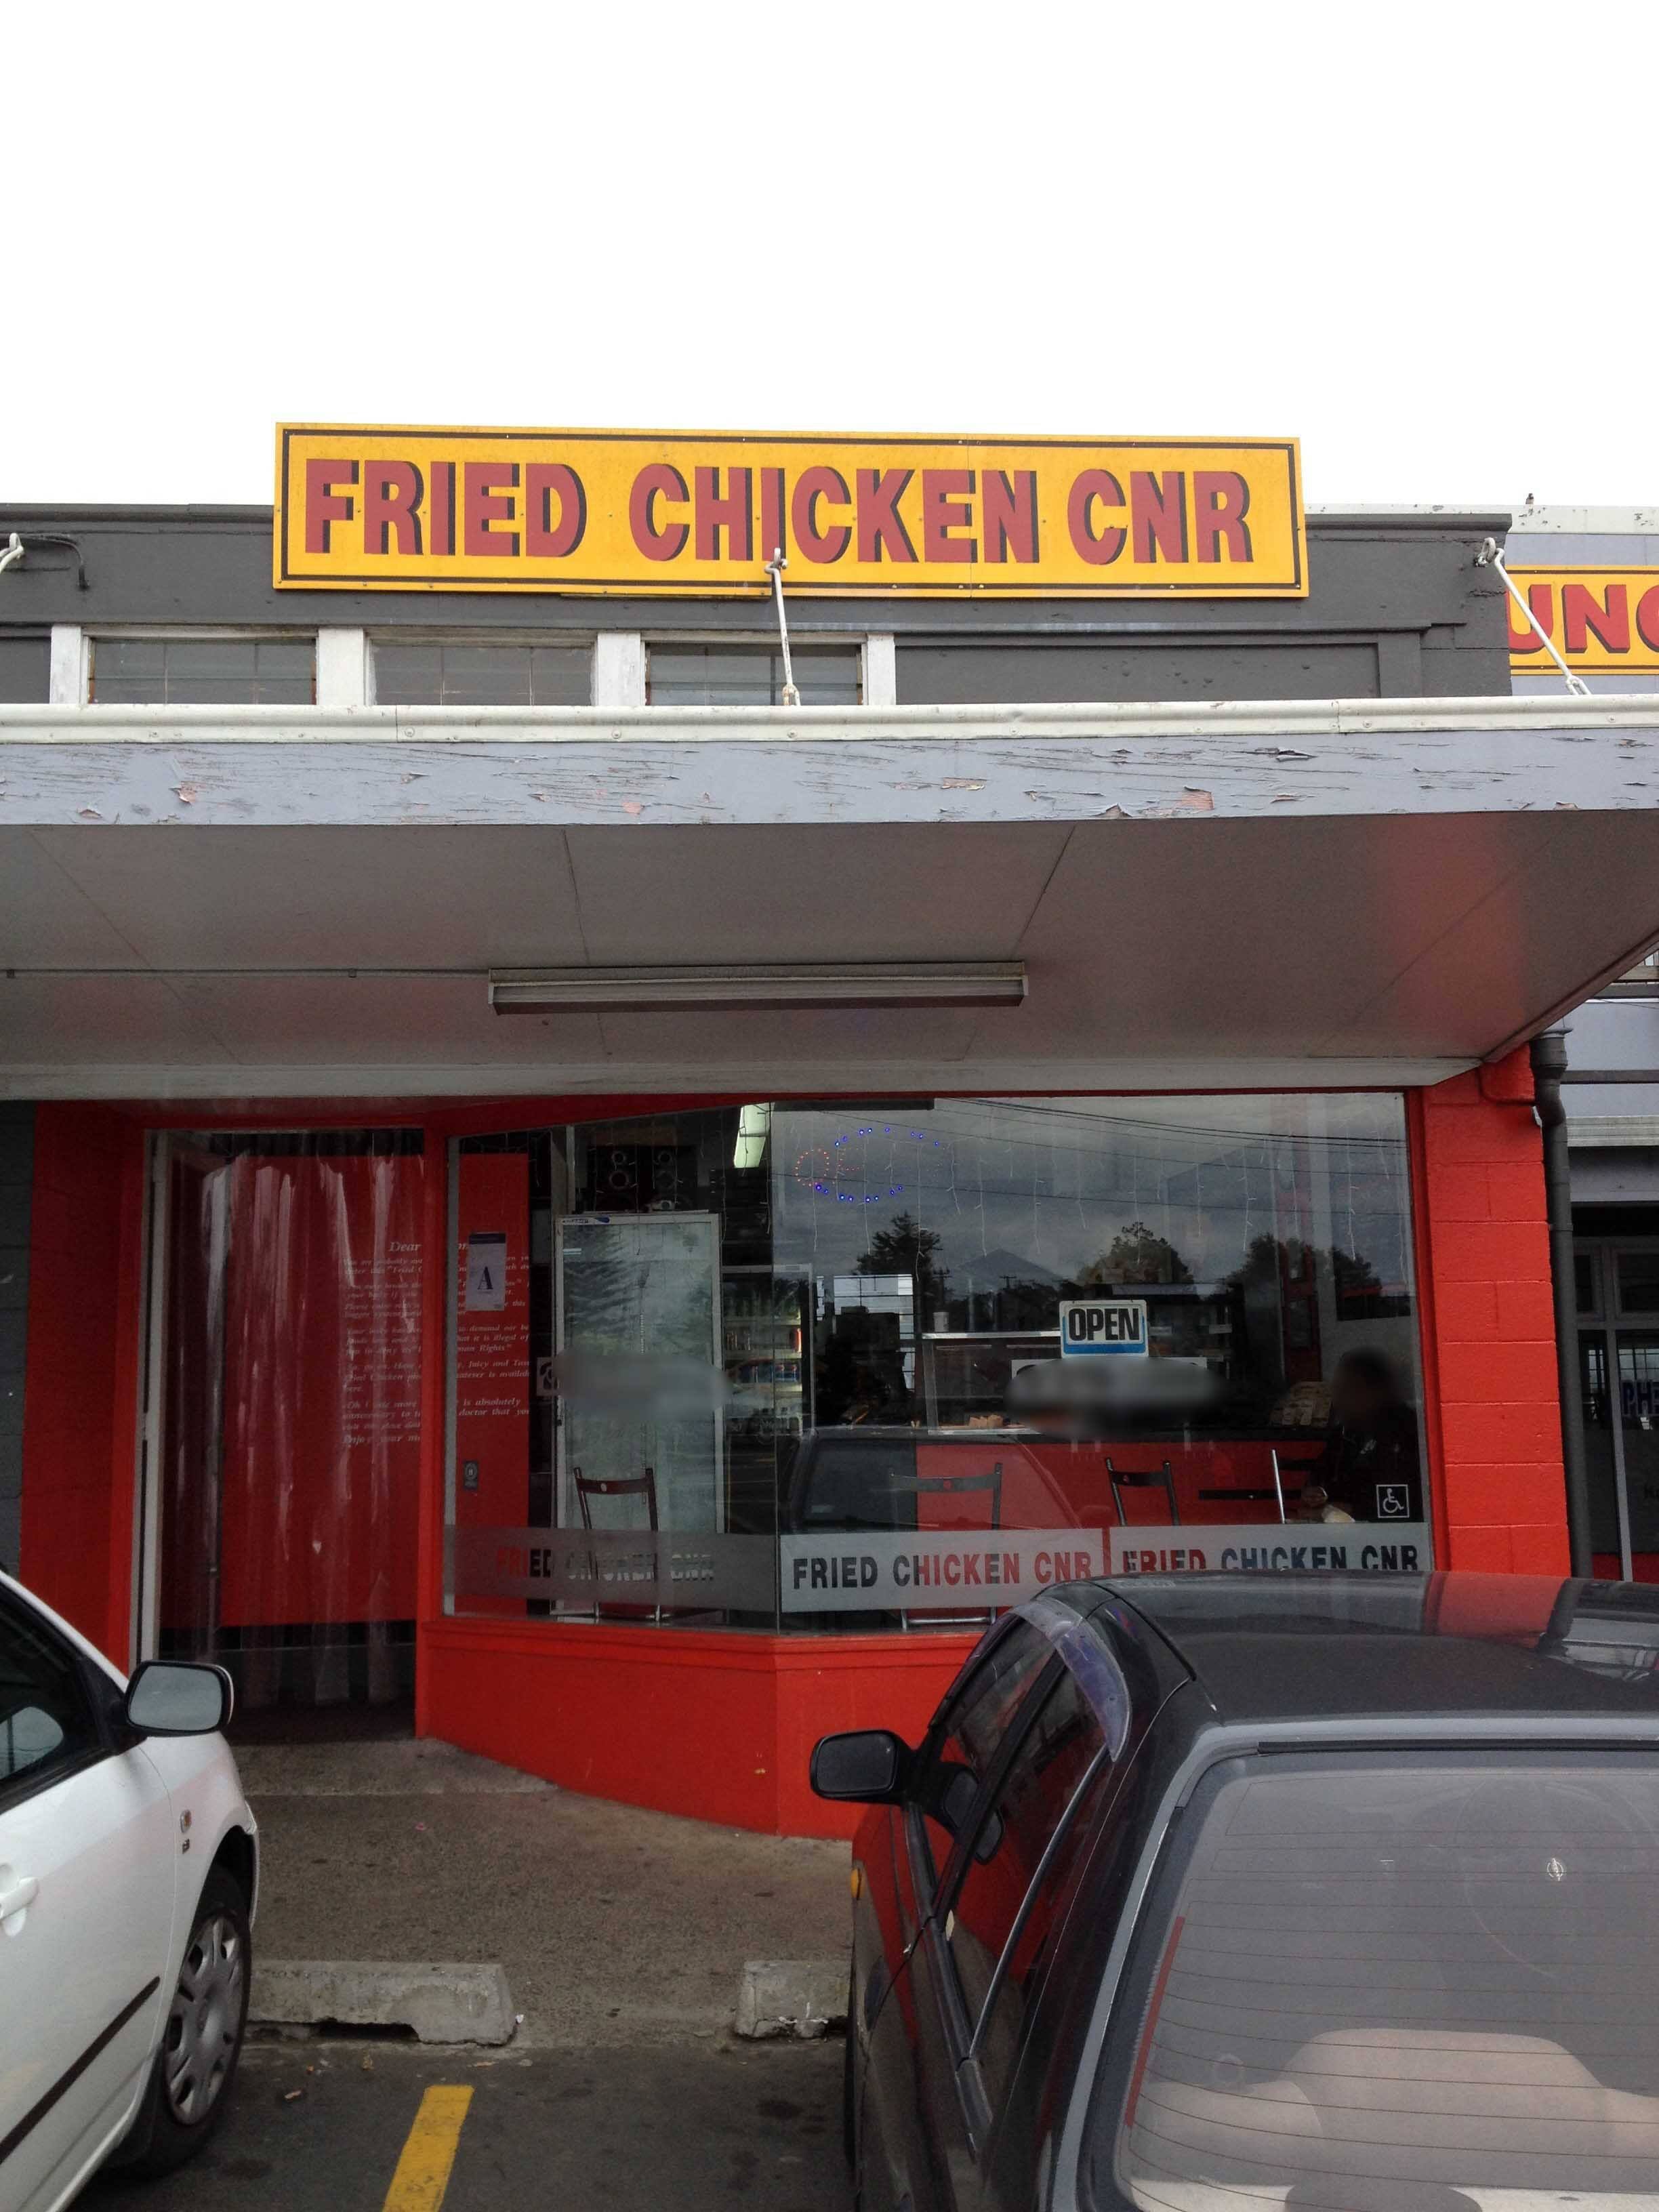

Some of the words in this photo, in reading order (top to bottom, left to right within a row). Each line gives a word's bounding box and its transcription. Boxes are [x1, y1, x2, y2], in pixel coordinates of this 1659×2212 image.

[305, 459, 587, 558] FRIED
[629, 463, 1040, 564] CHICKEN
[1067, 469, 1254, 565] CNR
[388, 1241, 422, 1253] Dear
[477, 1266, 494, 1290] A
[1068, 1307, 1140, 1341] OPEN
[476, 1396, 520, 1408] absolutely
[792, 1556, 878, 1589] FRIED
[893, 1553, 1021, 1586] CHICKEN
[1033, 1552, 1092, 1584] CNR
[1122, 1549, 1207, 1573] FRIED
[1221, 1547, 1347, 1570] CHICKEN
[1361, 1544, 1418, 1571] CNR
